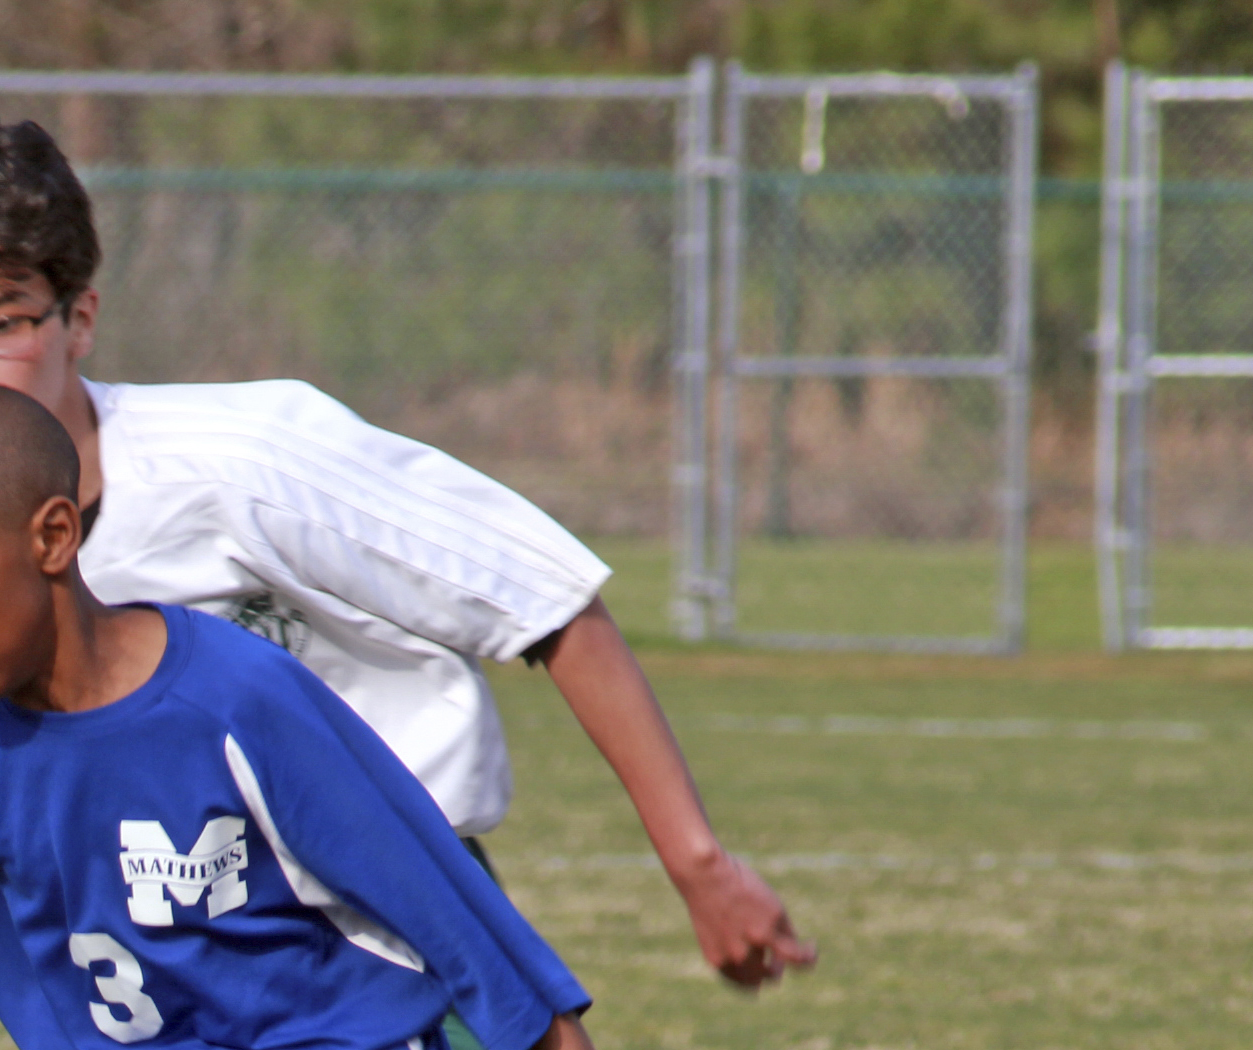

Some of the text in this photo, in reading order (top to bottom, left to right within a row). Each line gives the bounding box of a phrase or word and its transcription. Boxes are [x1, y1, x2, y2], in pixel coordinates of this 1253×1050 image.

[120, 814, 249, 927] M
[127, 847, 243, 880] MATHEWS
[69, 931, 164, 1044] 3
